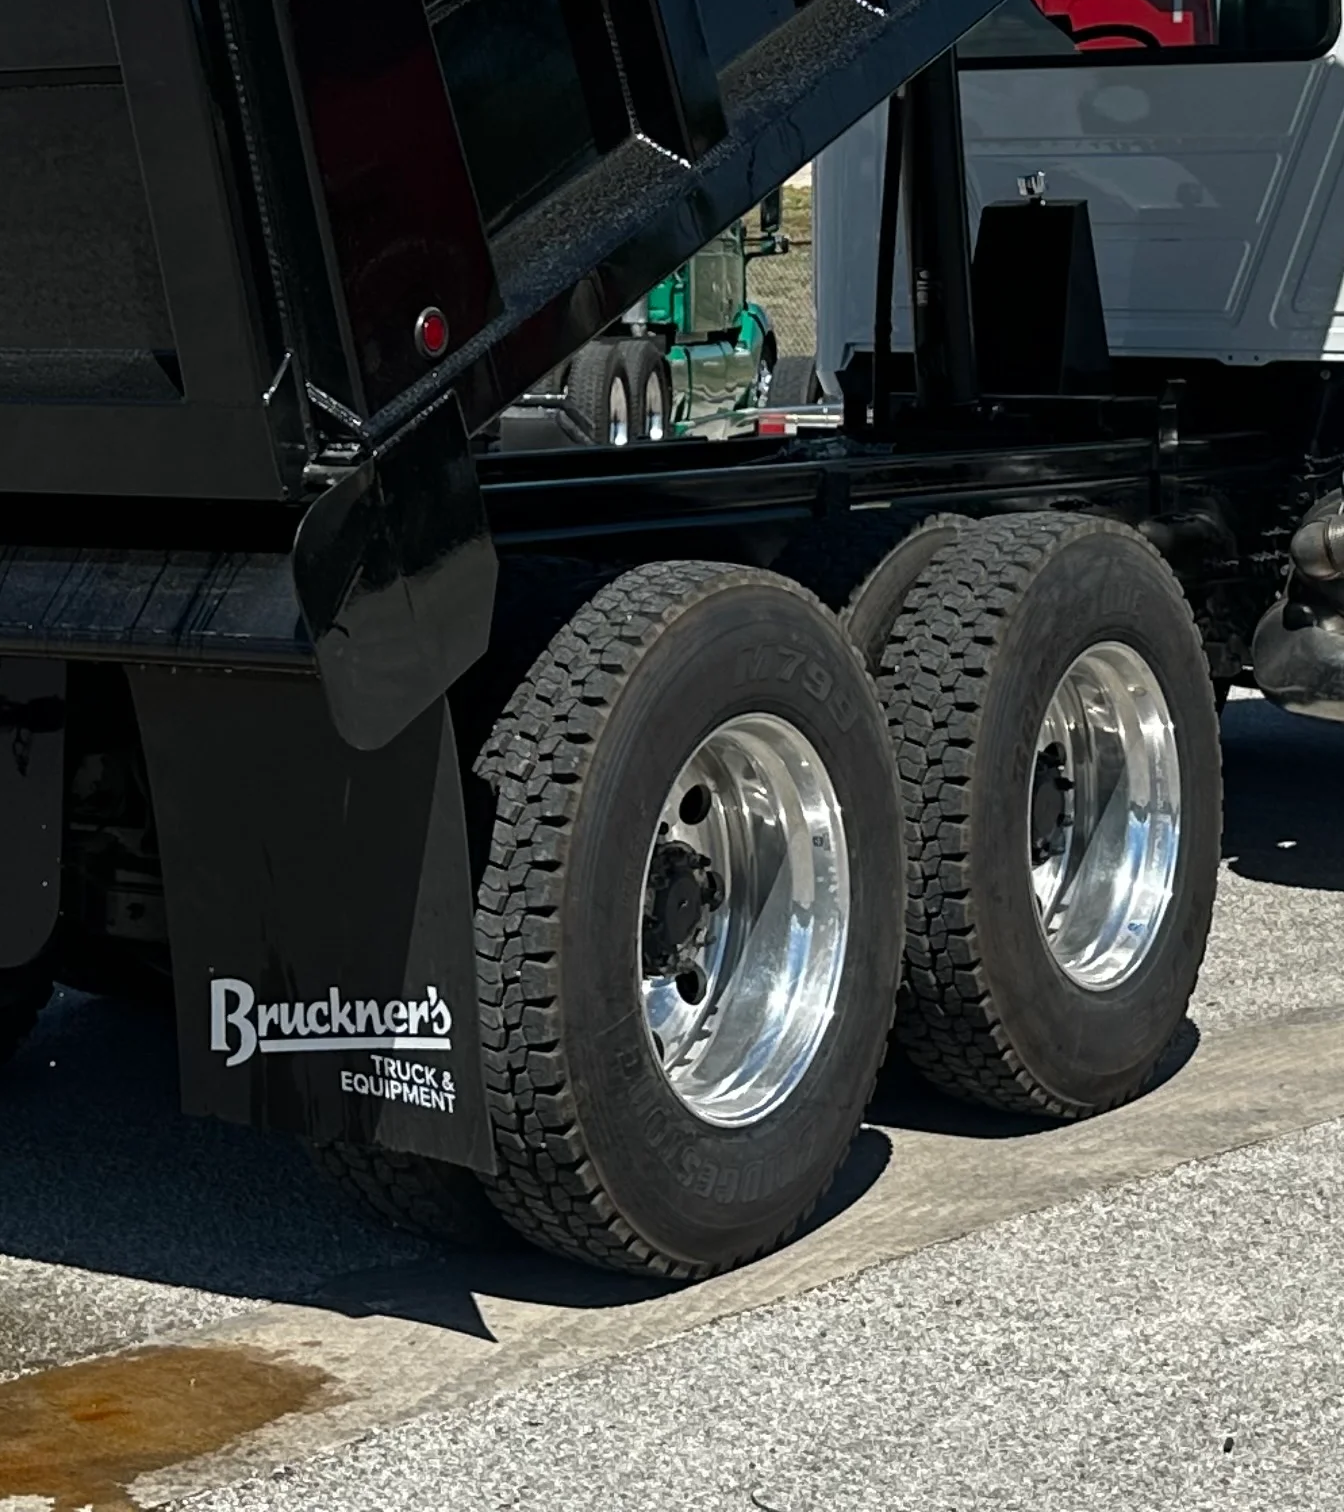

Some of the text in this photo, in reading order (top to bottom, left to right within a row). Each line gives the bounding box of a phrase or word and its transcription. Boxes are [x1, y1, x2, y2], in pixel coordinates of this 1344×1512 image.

[210, 977, 452, 1067] Bruckner's
[340, 1070, 456, 1114] EQUIPMENT
[370, 1054, 455, 1092] TRUCK &
